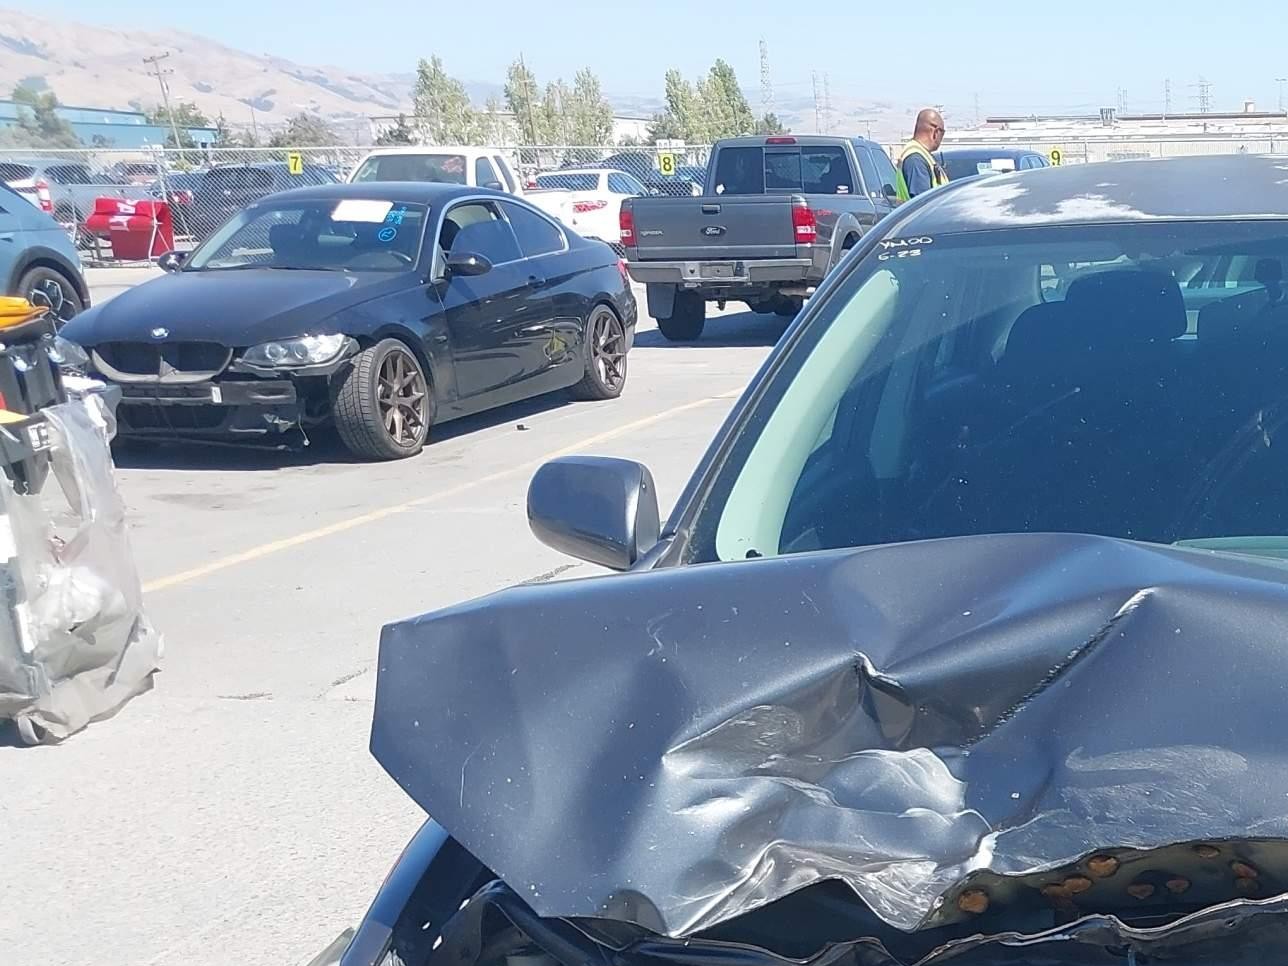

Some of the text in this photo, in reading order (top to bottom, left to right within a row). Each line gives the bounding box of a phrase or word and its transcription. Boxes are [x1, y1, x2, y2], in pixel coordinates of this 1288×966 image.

[290, 156, 299, 171] 7
[663, 156, 672, 171] 8
[1051, 150, 1060, 165] 9
